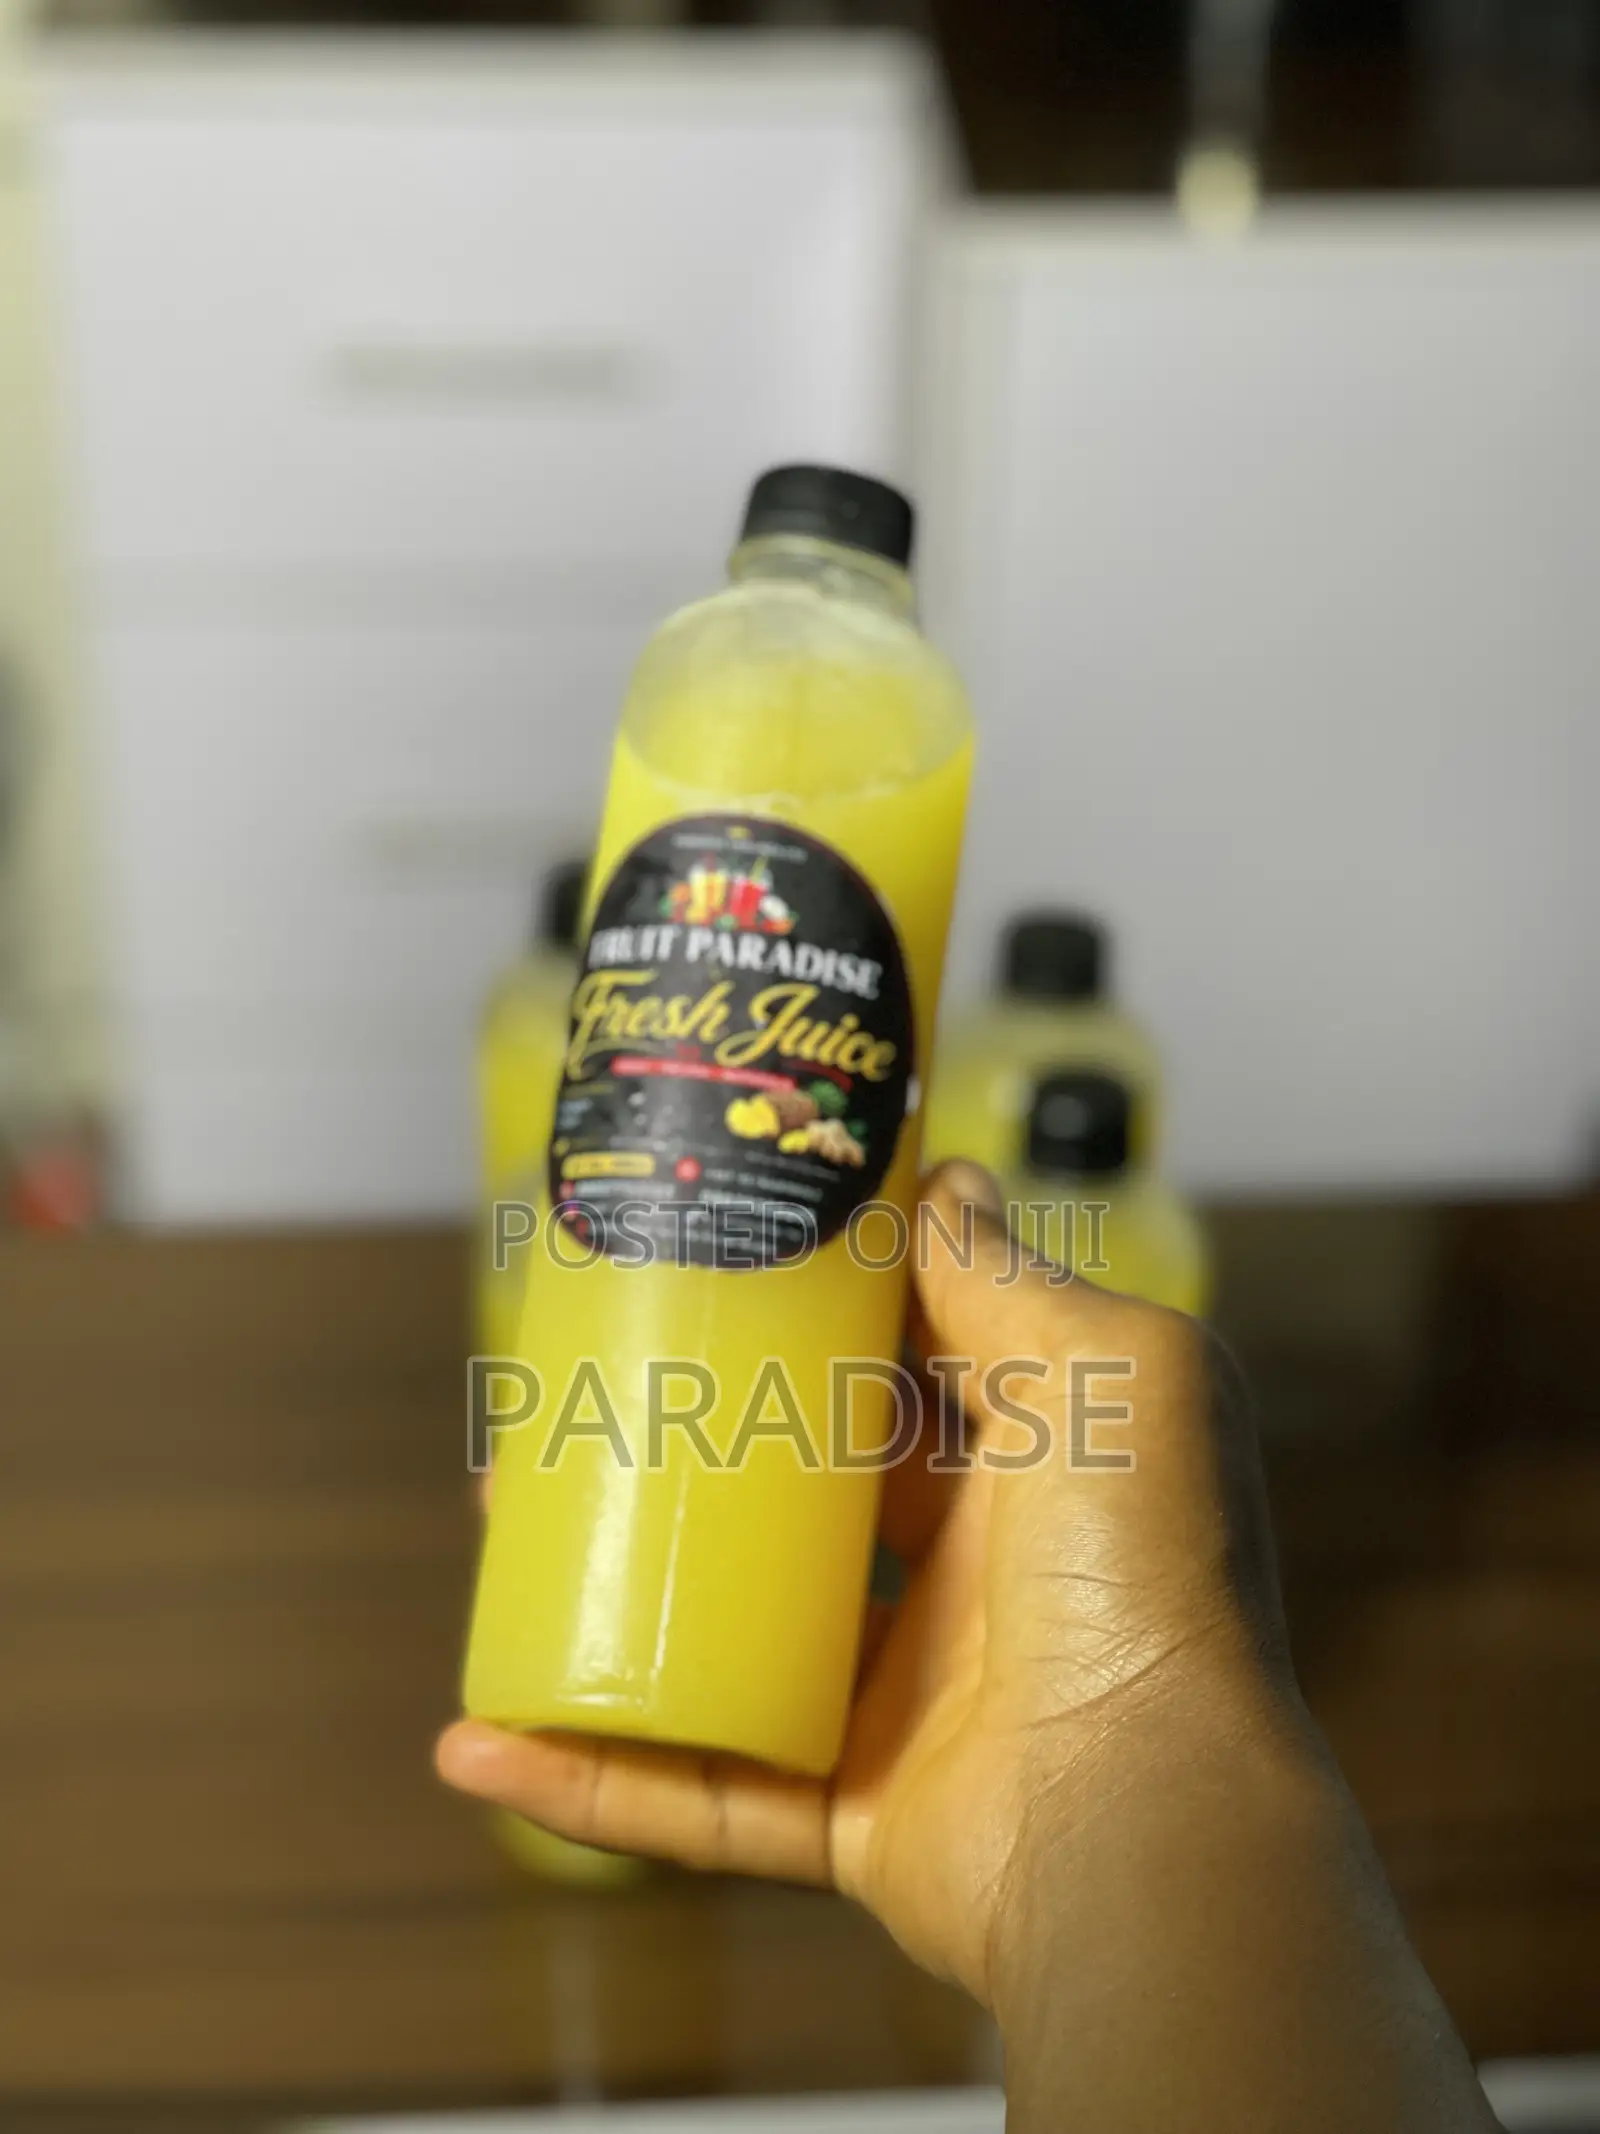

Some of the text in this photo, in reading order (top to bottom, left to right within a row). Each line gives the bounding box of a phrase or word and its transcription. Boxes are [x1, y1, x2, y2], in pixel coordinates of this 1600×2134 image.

[686, 930, 883, 999] PARADISE
[567, 968, 896, 1080] Fresh Juice
